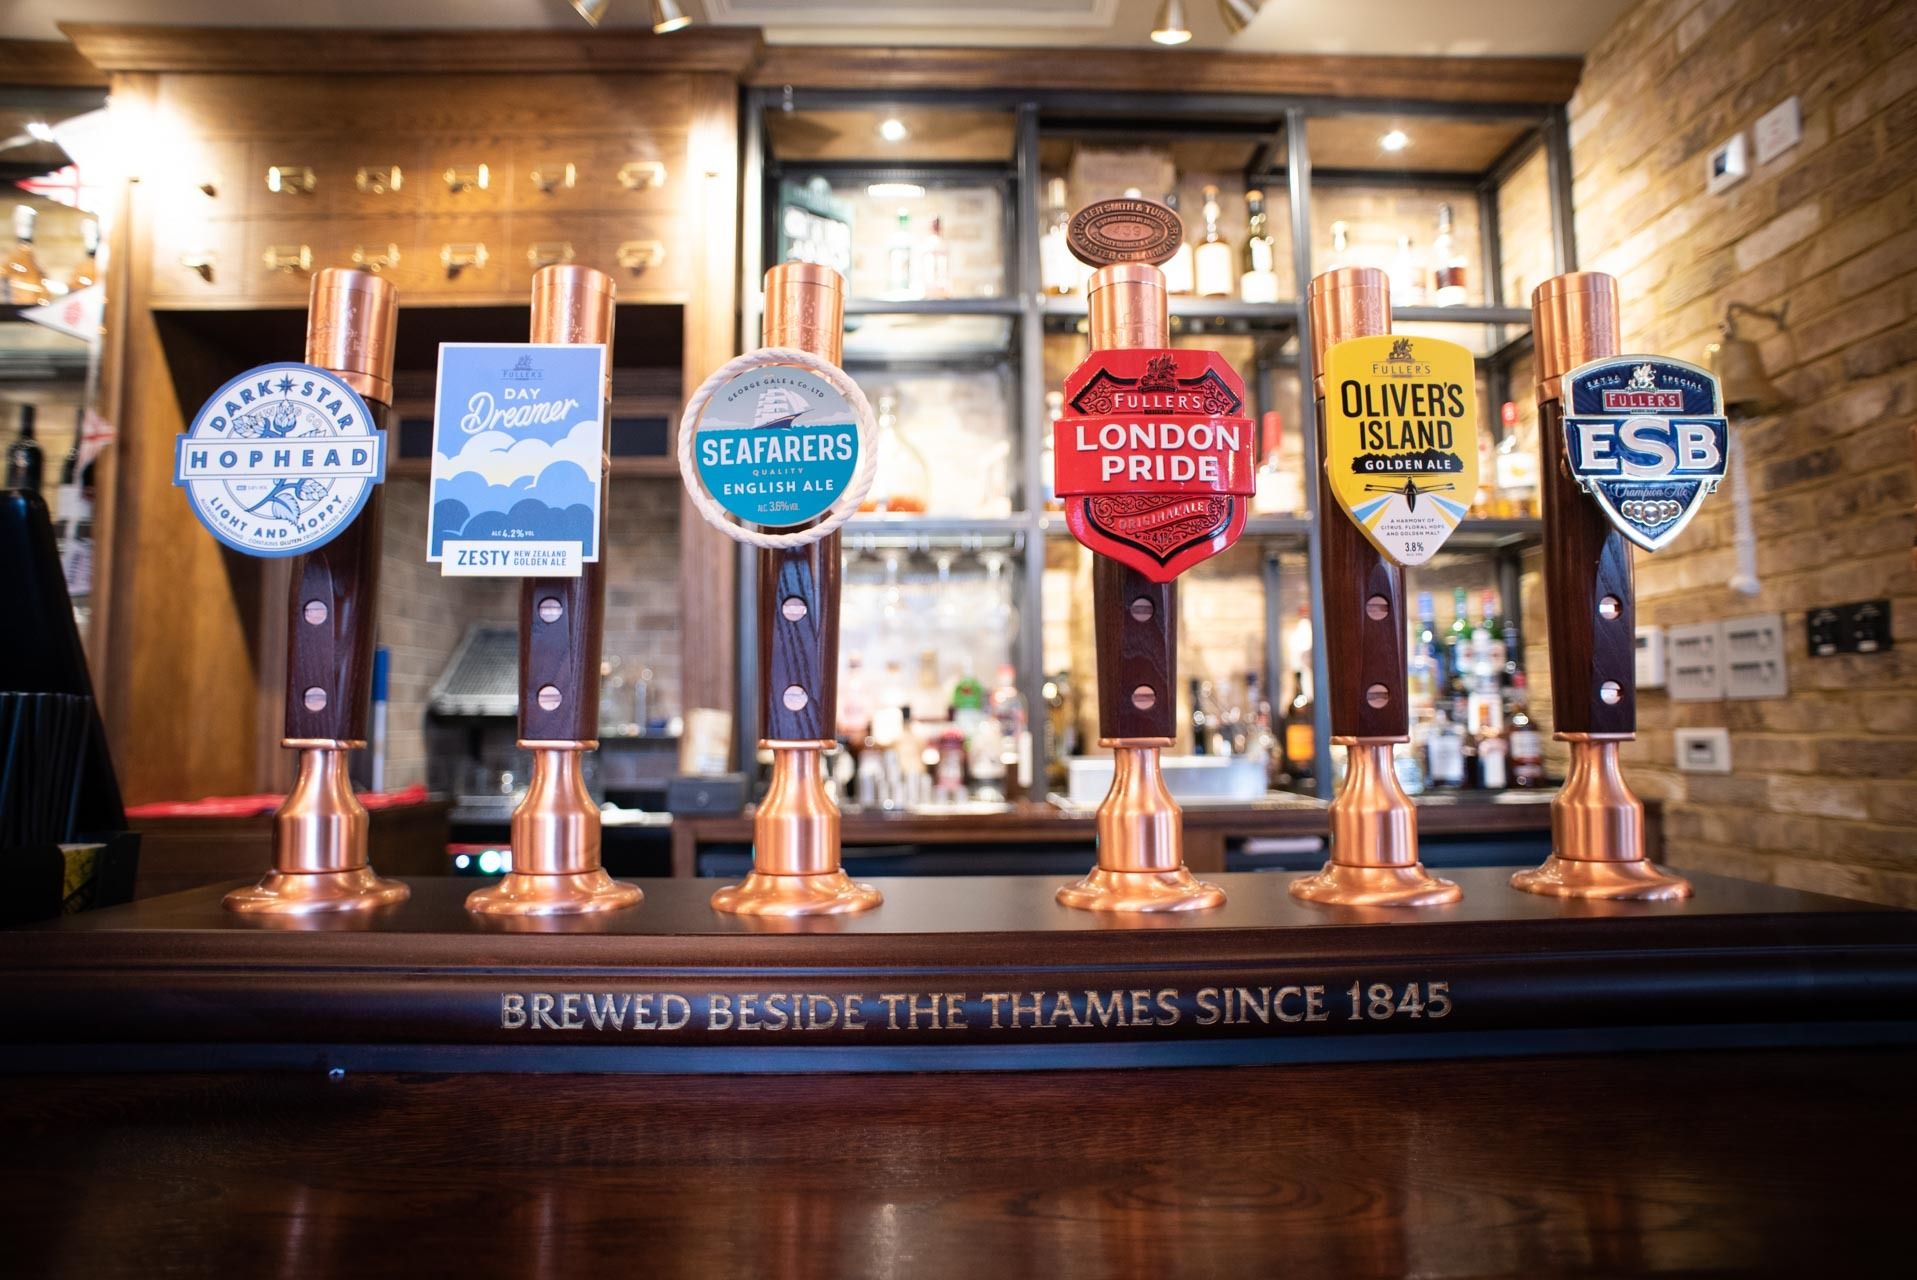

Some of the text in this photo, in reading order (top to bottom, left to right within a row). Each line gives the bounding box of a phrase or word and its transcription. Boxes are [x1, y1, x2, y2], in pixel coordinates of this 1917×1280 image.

[1074, 206, 1104, 235] FULLER
[1103, 202, 1134, 211] SMITH
[1135, 203, 1142, 211] &
[1144, 205, 1179, 235] TURNER
[1080, 238, 1116, 259] MASTER
[1372, 363, 1431, 374] FULLER'S
[728, 381, 761, 401] GEORGE
[811, 387, 824, 398] LTD
[1586, 374, 1703, 392] EXTRA SPECIAL
[504, 388, 541, 400] DAY
[1114, 393, 1201, 409] FULLER'S
[1341, 380, 1465, 418] OLIVER'S
[1609, 393, 1676, 407] FULLER'S
[210, 379, 354, 433] DARK STAR
[460, 391, 579, 434] Dreamer
[1076, 423, 1240, 451] LONDON
[1360, 420, 1453, 450] ISLAND
[702, 433, 852, 466] SEAFARERS
[1577, 417, 1720, 478] ESB
[191, 448, 368, 468] HOPHEAD
[1364, 459, 1451, 470] GOLDEN ALE
[752, 467, 804, 477] QUALITY
[1102, 455, 1219, 481] PRIDE
[724, 479, 834, 495] ENGLISH ALE
[1613, 486, 1663, 501] Champion
[210, 495, 342, 538] LIGHT AND HOPPY
[1183, 502, 1204, 514] ALE
[502, 529, 524, 538] 4.2%
[1405, 542, 1424, 552] 3.8%
[457, 550, 510, 566] ZESTY
[513, 558, 567, 566] GOLDEN ALE
[500, 980, 1451, 1031] BREWED BESIDE THE THAMES SINCE 1845
